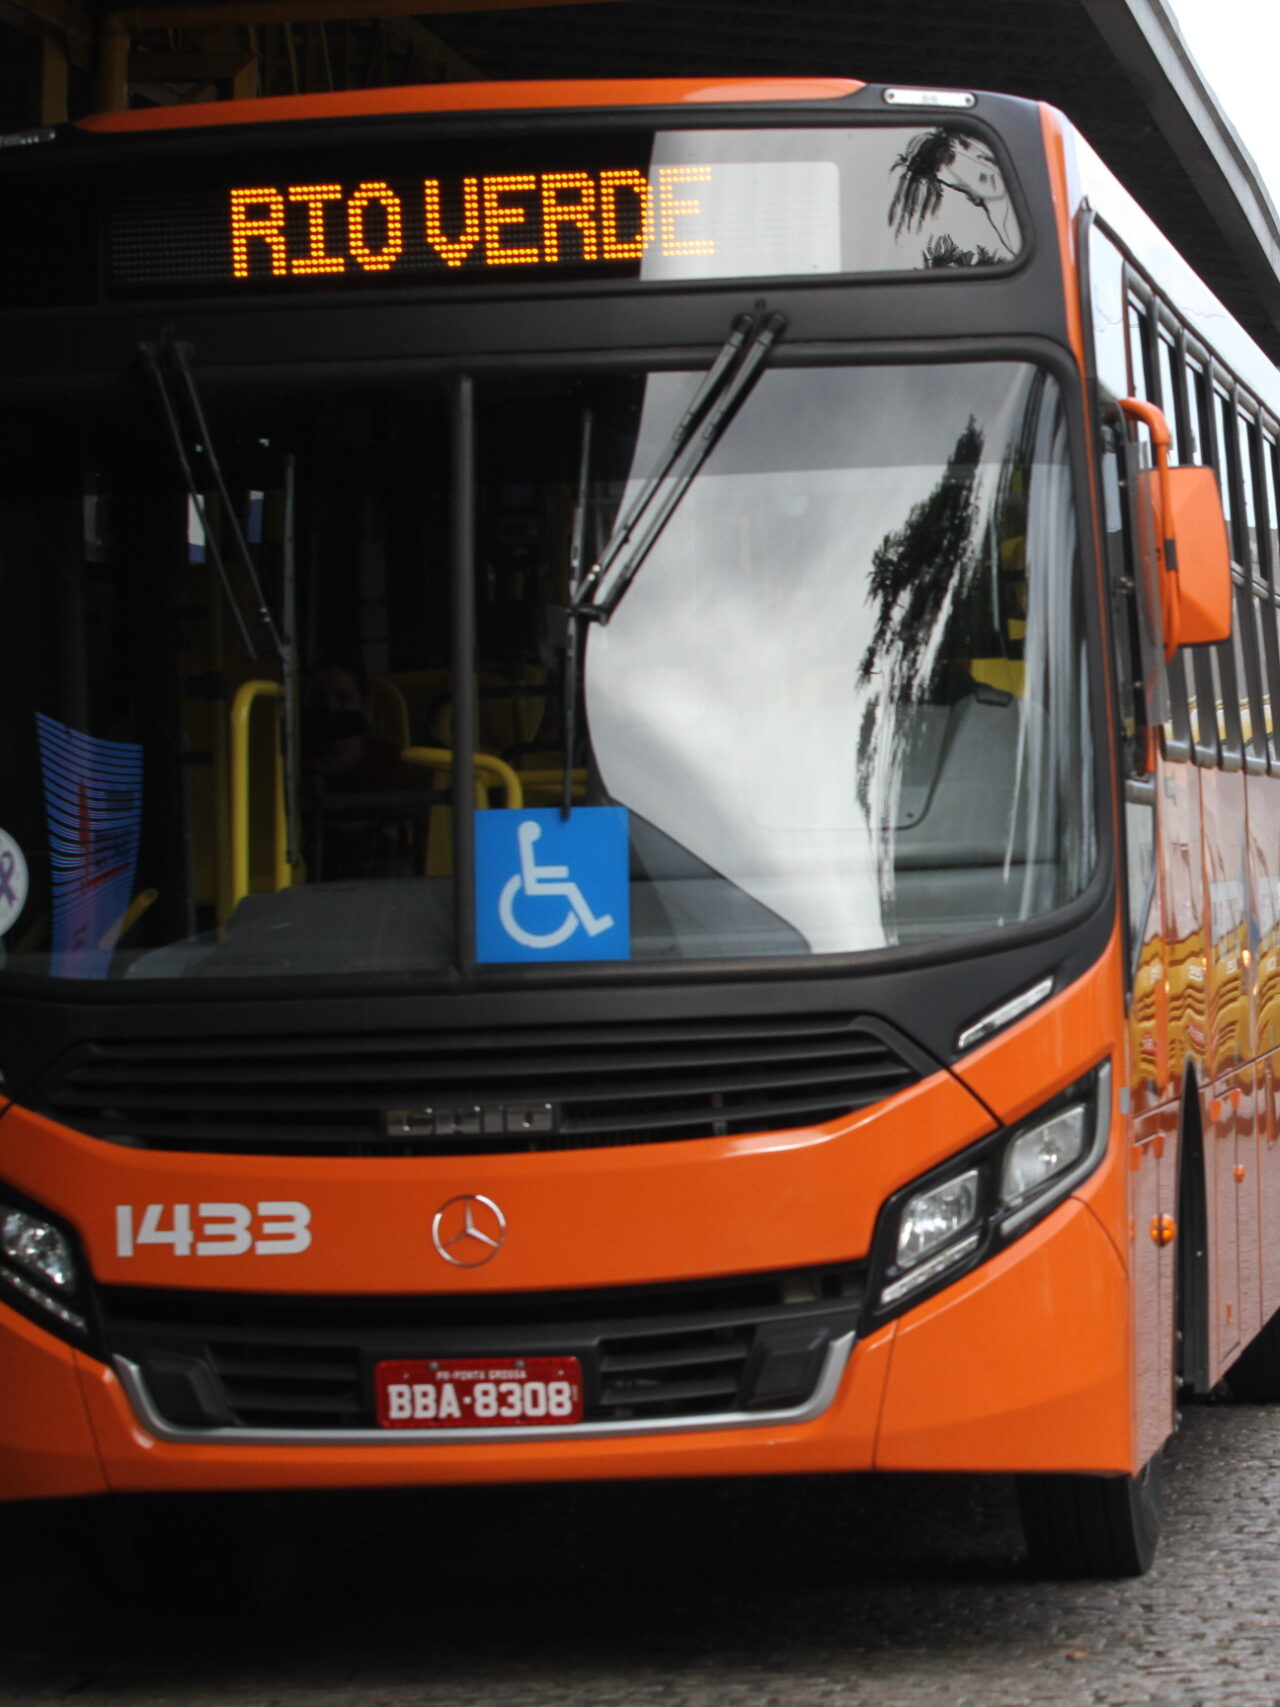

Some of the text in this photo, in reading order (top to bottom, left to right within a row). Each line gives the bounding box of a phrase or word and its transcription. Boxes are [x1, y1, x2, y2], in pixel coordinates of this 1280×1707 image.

[230, 167, 714, 278] RIO VERDE
[116, 1201, 312, 1257] 1433
